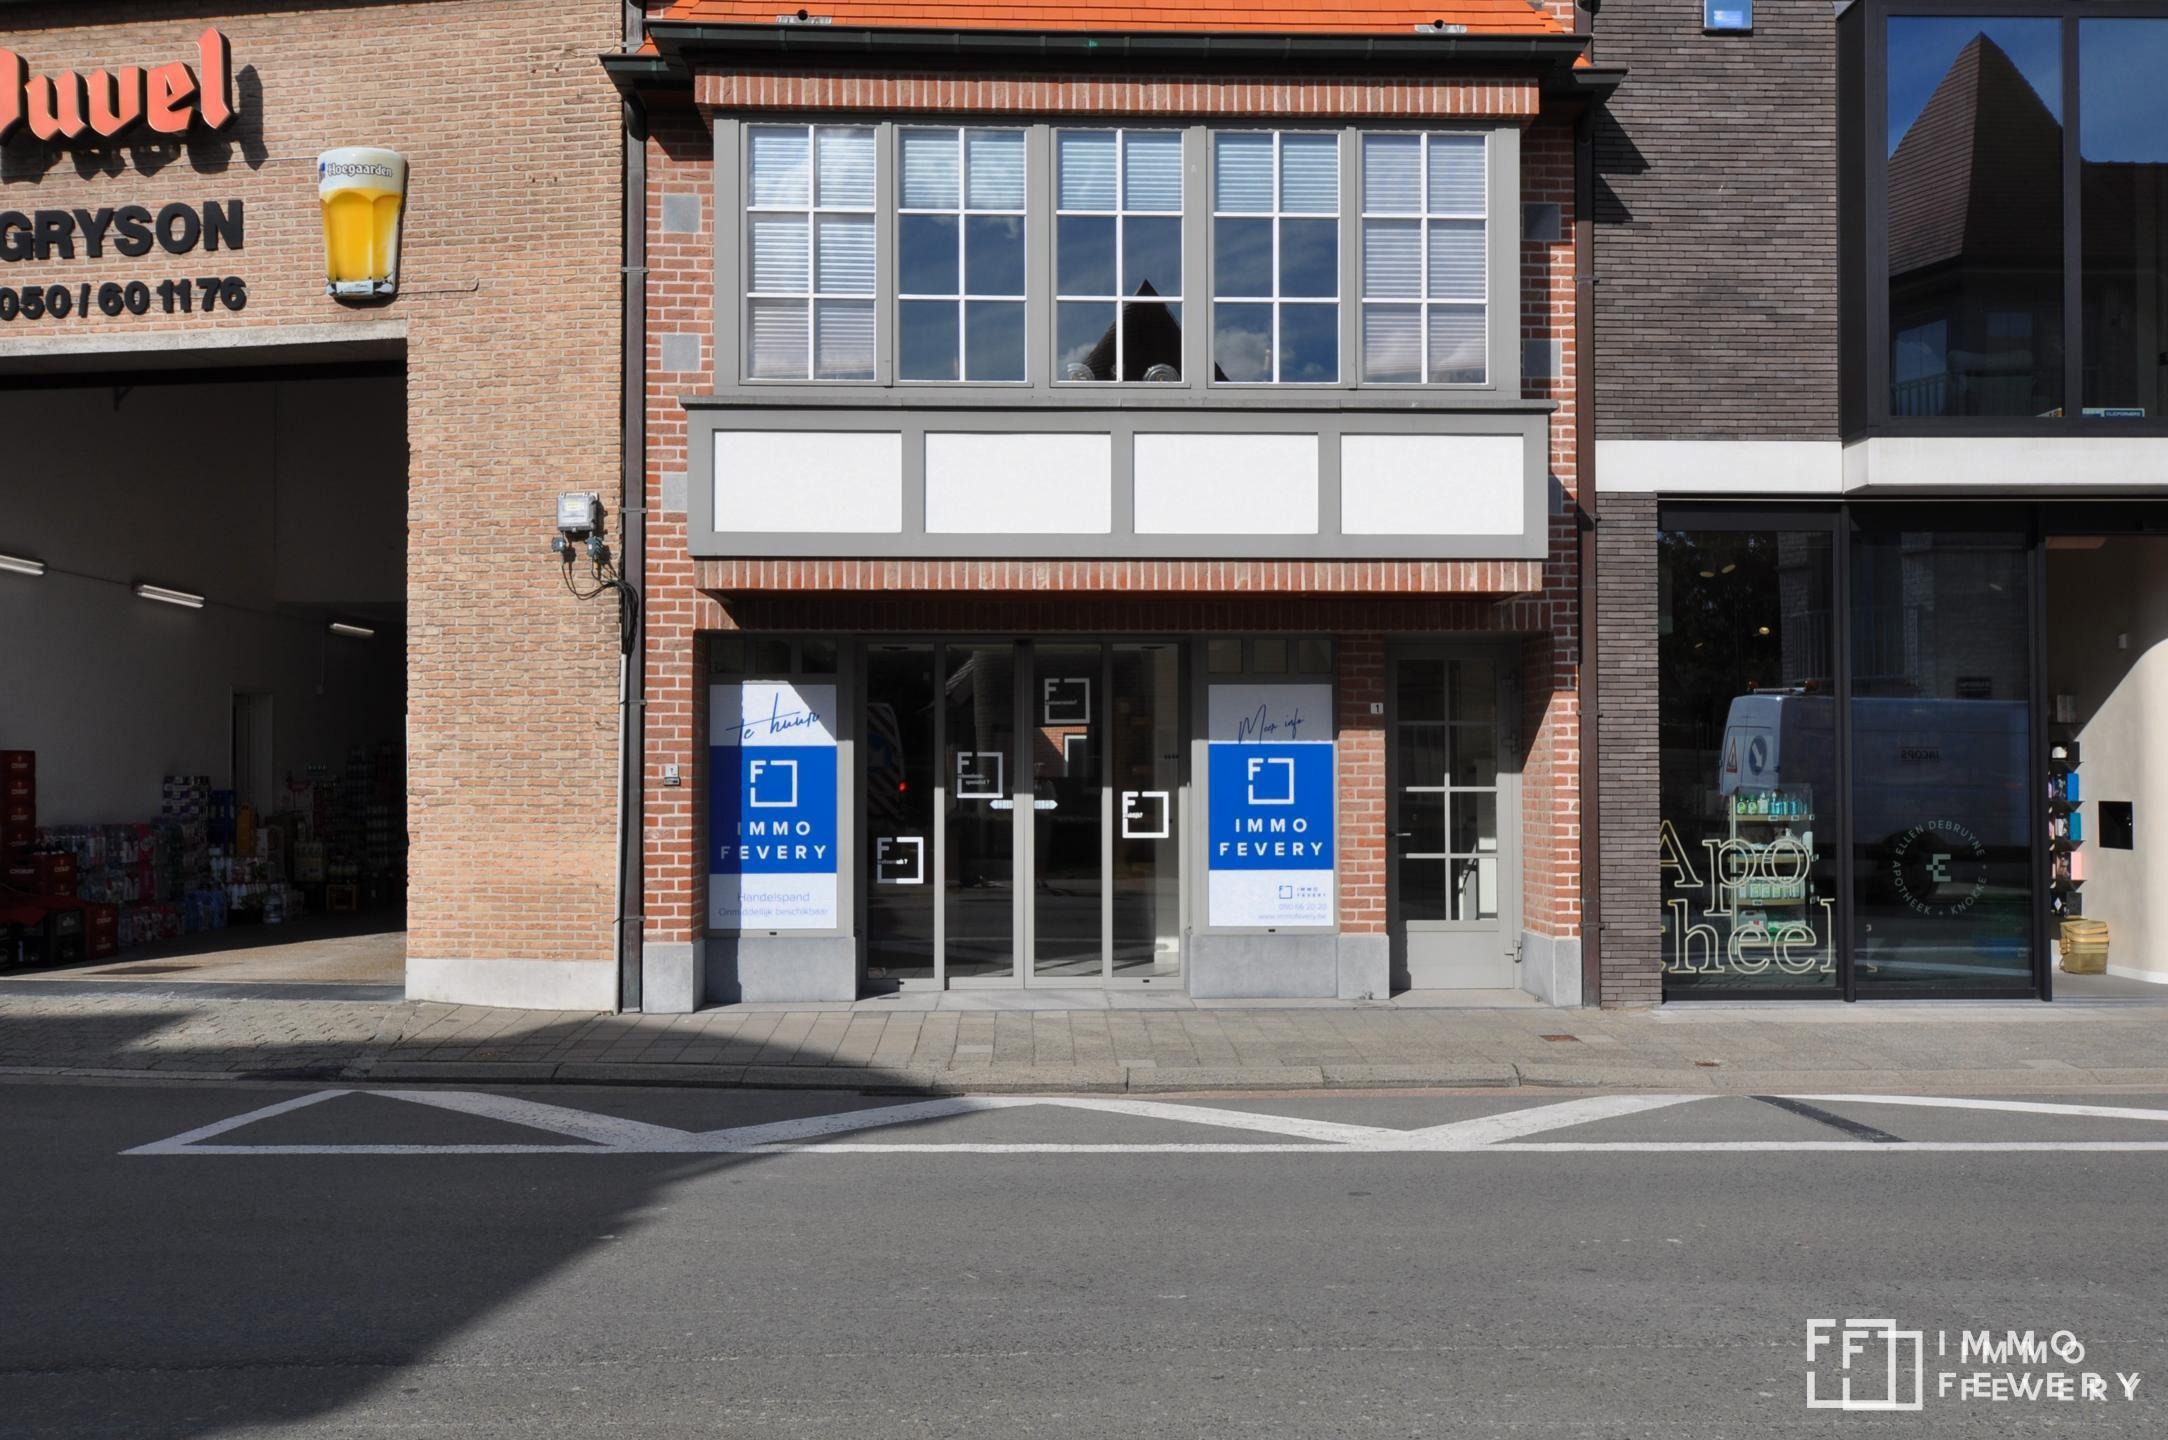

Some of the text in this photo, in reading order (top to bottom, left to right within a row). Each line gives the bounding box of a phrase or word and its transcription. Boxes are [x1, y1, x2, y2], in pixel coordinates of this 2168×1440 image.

[327, 162, 393, 177] Hoegaarden
[737, 821, 811, 836] IMMO
[1235, 818, 1308, 833] IMMO
[1896, 820, 1985, 857] ELLEN DEBRUYNE
[720, 845, 827, 860] FEVERY
[1219, 842, 1325, 857] FEVERY
[1660, 819, 1810, 917] Apo
[1892, 860, 1987, 916] APOTHEEK KNOKKE
[737, 892, 811, 904] Handelspand
